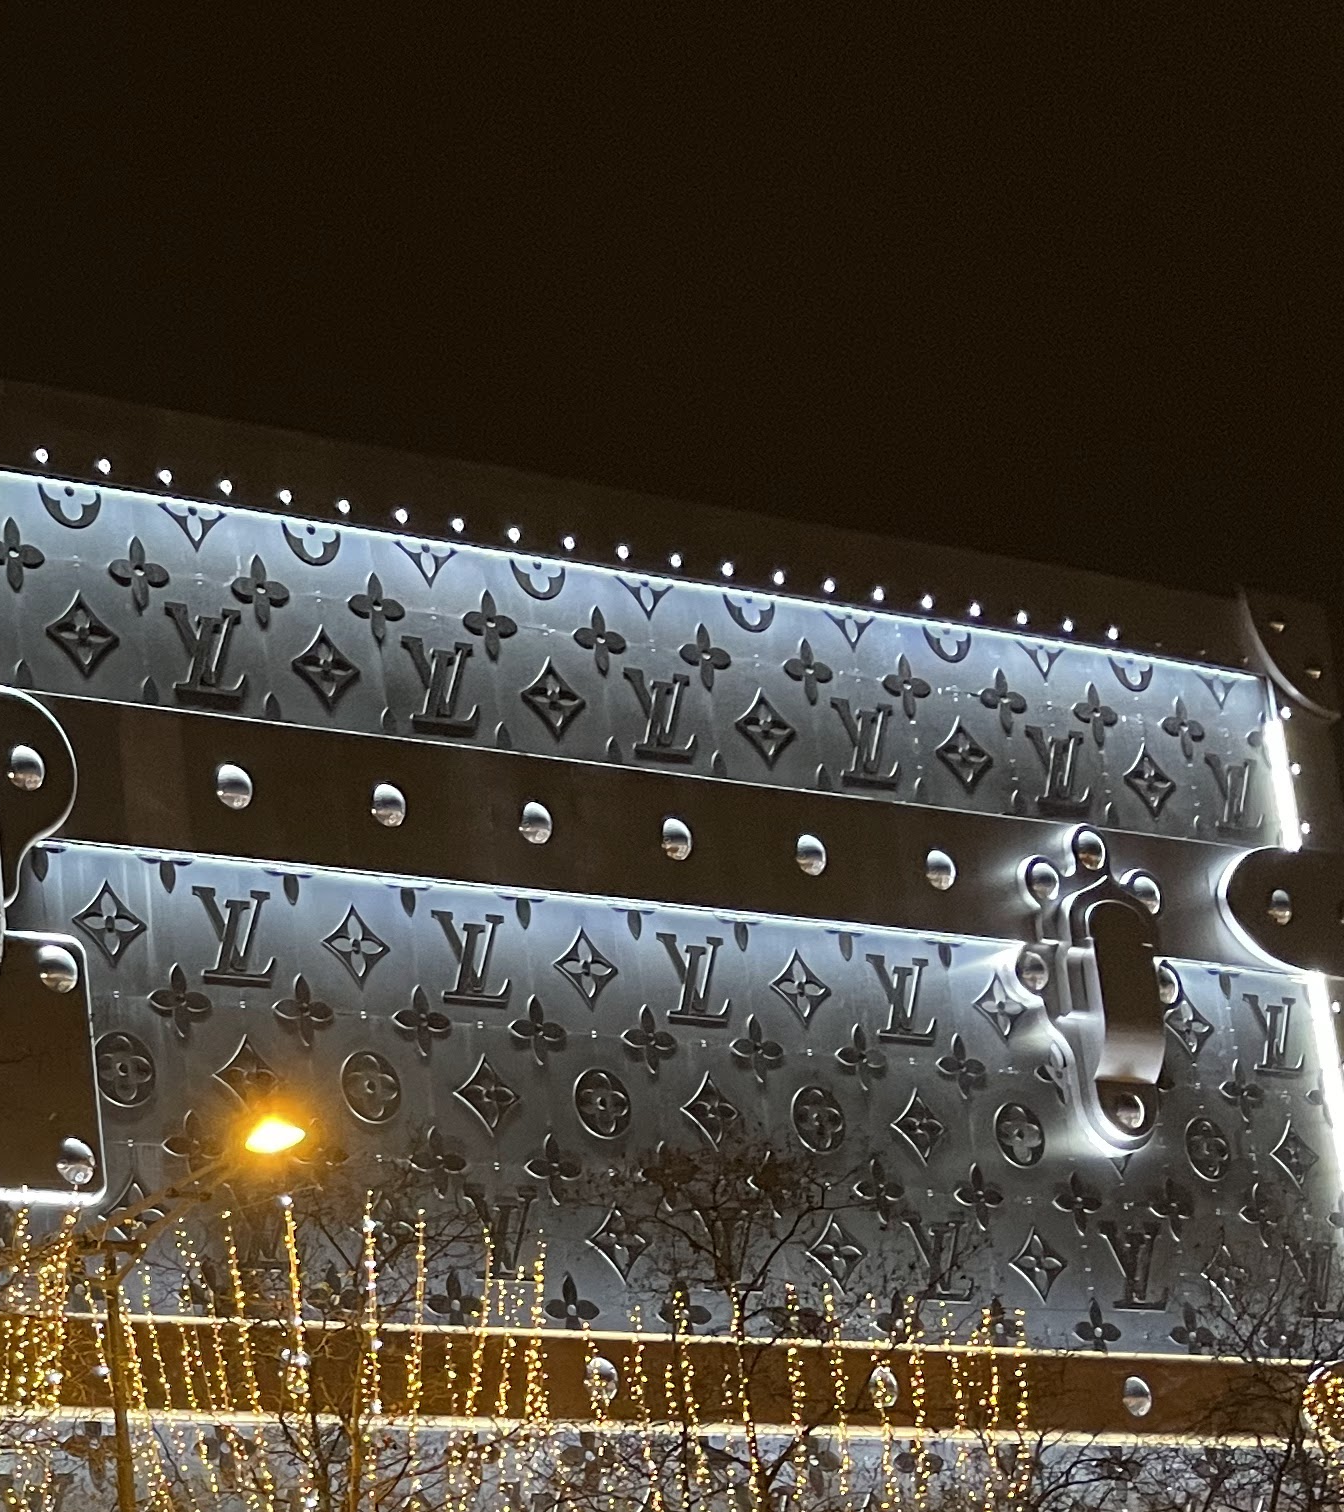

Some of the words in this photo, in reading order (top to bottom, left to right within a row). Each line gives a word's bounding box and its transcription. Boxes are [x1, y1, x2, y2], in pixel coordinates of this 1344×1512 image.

[164, 602, 246, 701] LV
[402, 635, 480, 736] LV
[623, 667, 696, 761] LV
[830, 697, 899, 789] LV
[1024, 725, 1090, 809] LV
[192, 886, 277, 988] LV
[432, 909, 510, 1007] LV
[656, 932, 731, 1028] LV
[866, 953, 938, 1045] LV
[1242, 992, 1305, 1076] LV
